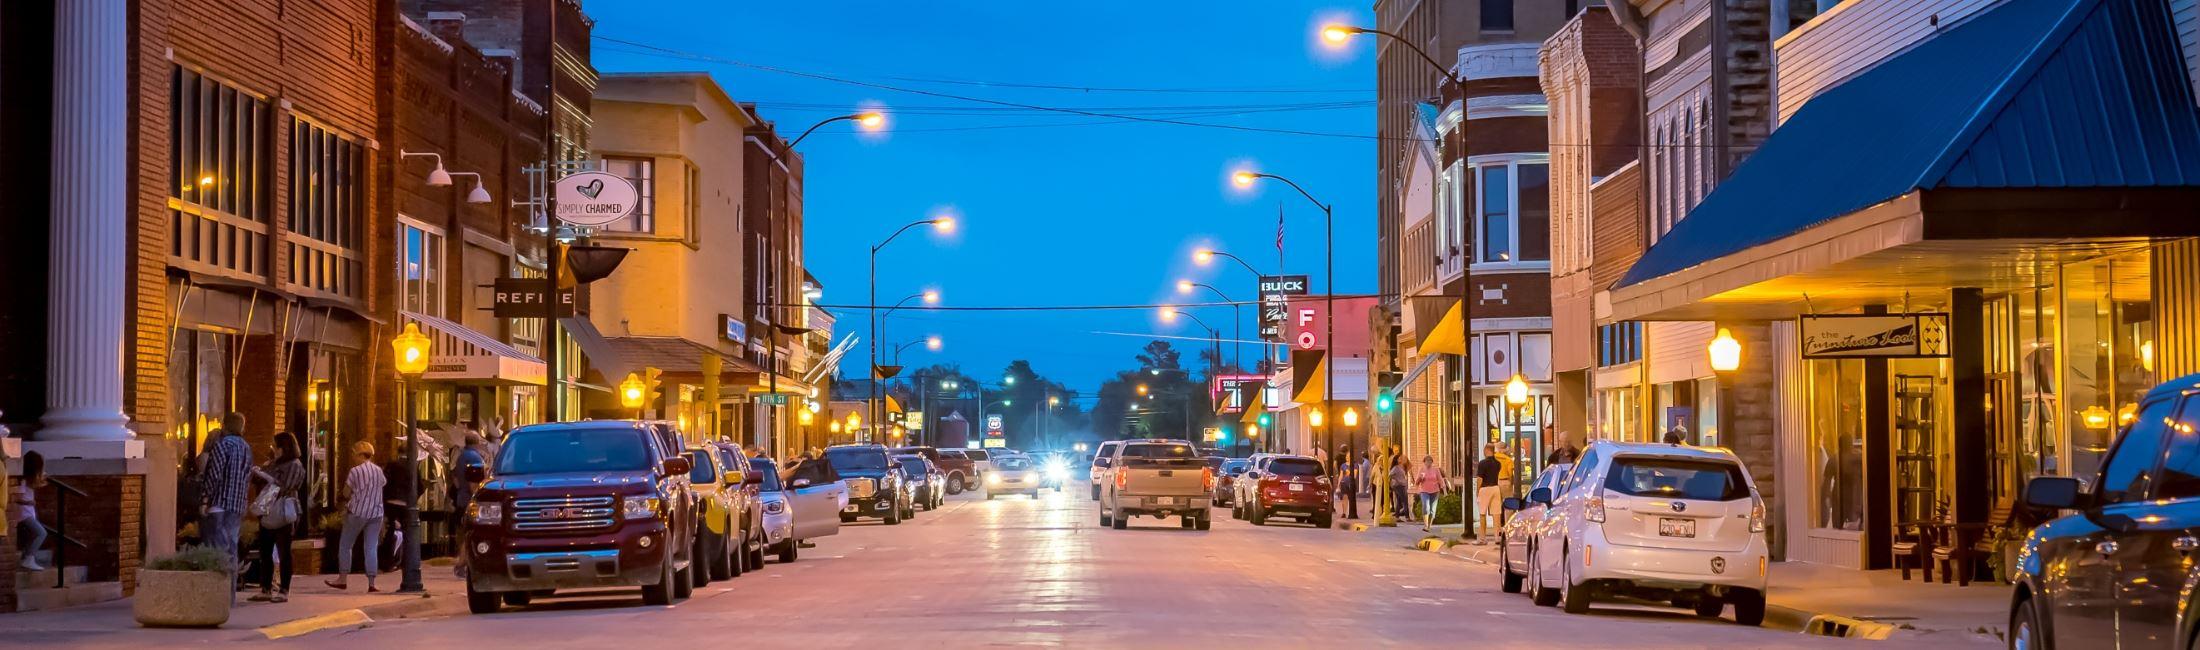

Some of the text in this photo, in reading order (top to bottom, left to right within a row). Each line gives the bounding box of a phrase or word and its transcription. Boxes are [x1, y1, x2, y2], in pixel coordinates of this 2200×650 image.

[558, 203, 622, 214] SIMPLY CHARMED
[1261, 281, 1303, 291] BUICK
[496, 292, 573, 304] REFIE
[1821, 331, 1839, 339] the
[1804, 335, 1878, 354] Furniture
[777, 395, 785, 404] ST
[539, 507, 583, 519] GMC
